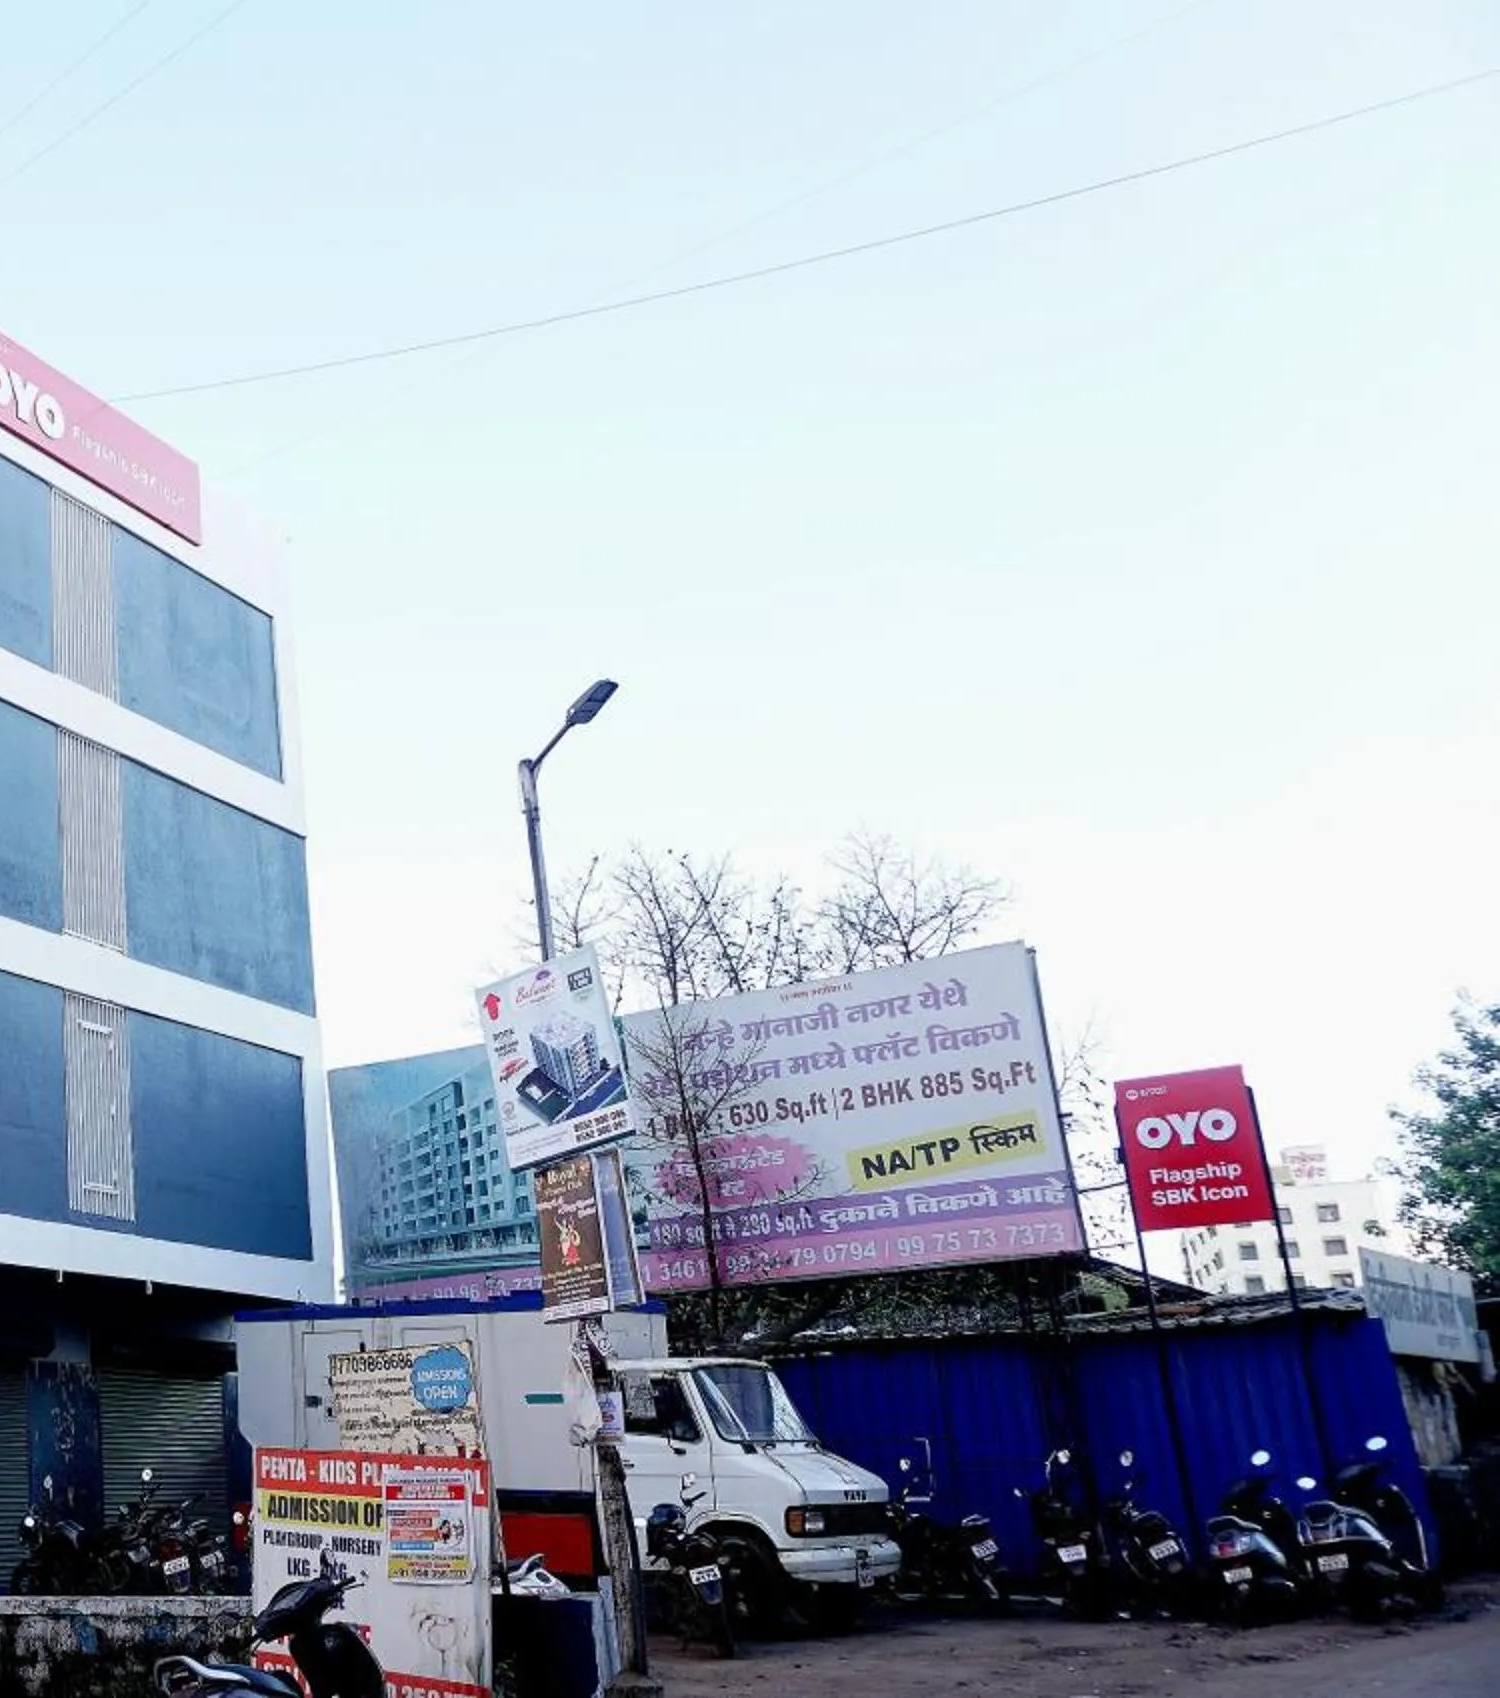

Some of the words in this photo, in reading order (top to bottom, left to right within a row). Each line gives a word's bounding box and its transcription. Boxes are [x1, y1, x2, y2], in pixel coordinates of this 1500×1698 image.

[739, 1002, 839, 1041] मानाजी
[845, 995, 912, 1023] नगर
[917, 978, 970, 1010] येथे
[788, 1042, 848, 1075] मध्ये
[925, 1012, 1022, 1054] विकणे
[729, 1101, 769, 1127] 630
[776, 1092, 828, 1123] Sq.ft
[840, 1087, 855, 1111] 2
[861, 1077, 914, 1108] BHK
[920, 1071, 965, 1099] 885
[971, 1060, 1037, 1095] Sq.Ft
[1135, 1108, 1237, 1149] OYO
[861, 1137, 961, 1180] NA/TP
[1150, 1161, 1242, 1186] Flagship
[775, 1206, 815, 1236] sq.ft
[906, 1185, 999, 1217] विकणे
[1006, 1177, 1067, 1205] आहे
[1152, 1187, 1199, 1206] SBK
[1201, 1184, 1249, 1201] Icon
[823, 1241, 877, 1264] 0794
[897, 1235, 926, 1258] 99
[931, 1231, 961, 1252] 75
[968, 1228, 997, 1248] 73
[1005, 1223, 1065, 1246] 7373
[423, 1384, 457, 1399] OPEN
[261, 1456, 306, 1481] PENTA
[319, 1458, 357, 1485] KIDS
[268, 1495, 359, 1525] ADMISSION
[264, 1529, 323, 1551] PLAYGROUP
[332, 1536, 382, 1556] NURSERY
[287, 1557, 311, 1577] LKG
